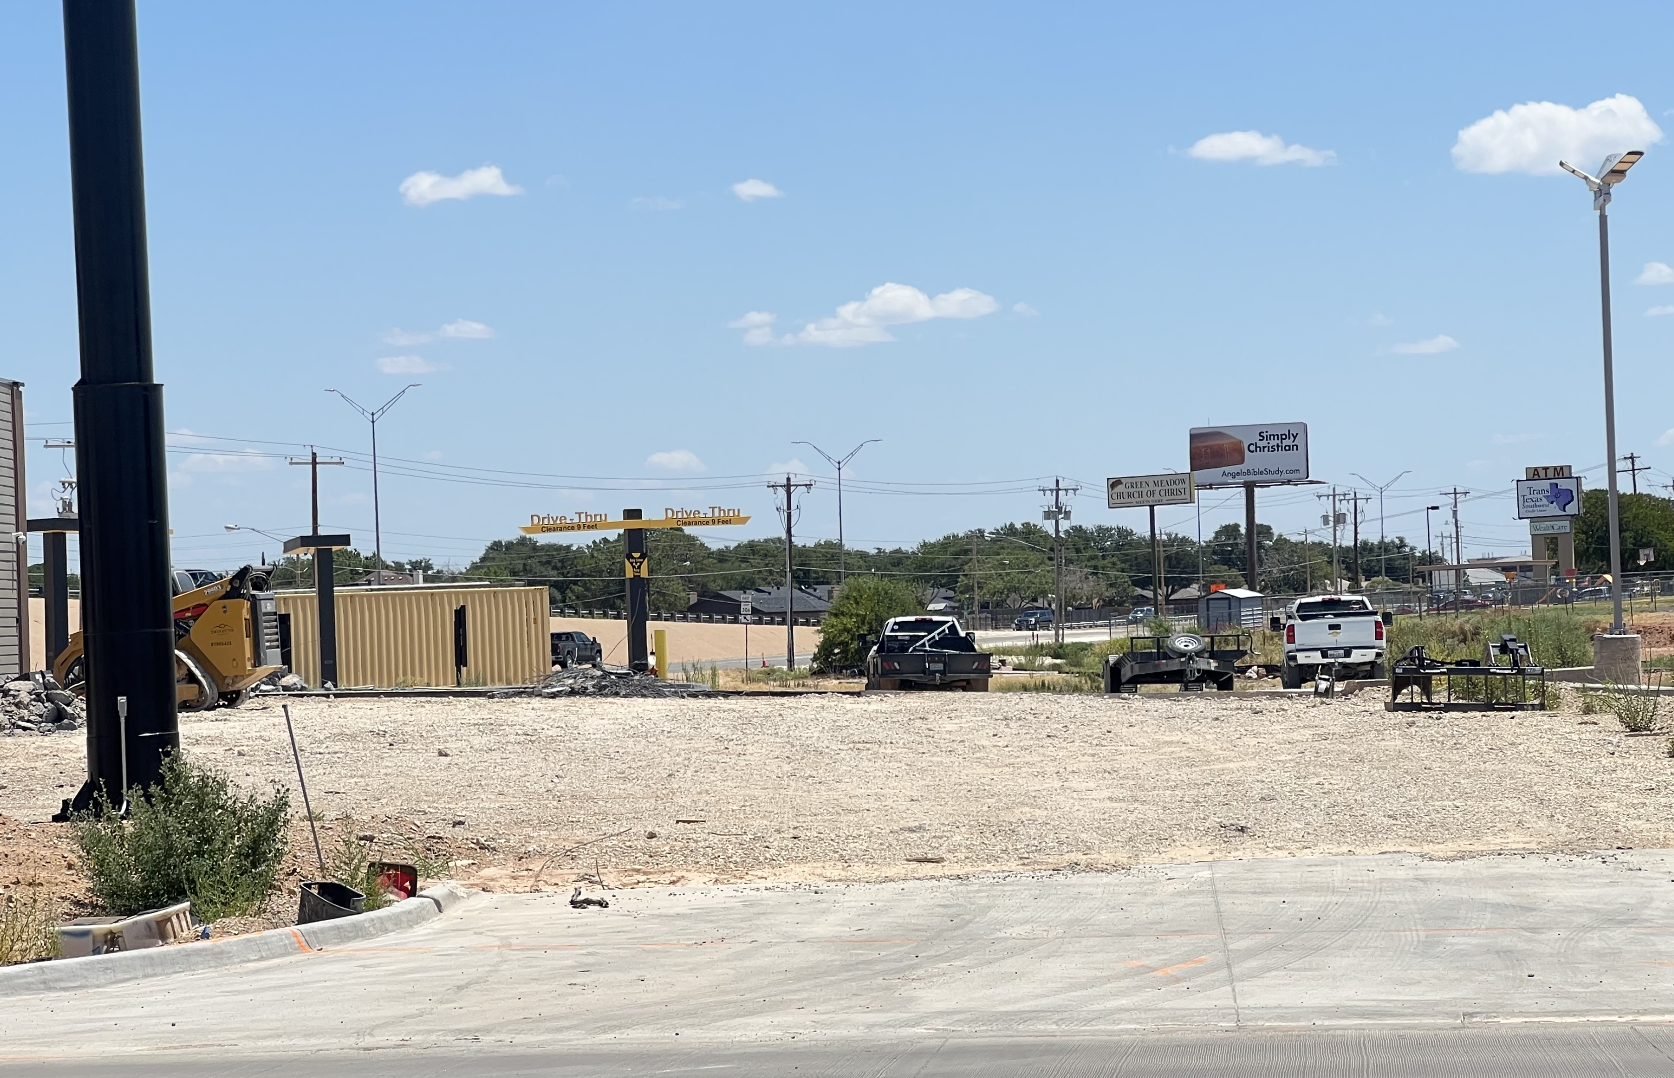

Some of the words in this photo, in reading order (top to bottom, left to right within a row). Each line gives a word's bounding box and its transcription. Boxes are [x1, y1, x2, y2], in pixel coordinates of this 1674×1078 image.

[1258, 429, 1299, 443] Simply
[1247, 442, 1299, 453] Christian
[1221, 467, 1301, 479] AngeloBibleStudy.com
[1532, 466, 1564, 478] ATM
[1124, 480, 1150, 489] GREEN
[1153, 478, 1187, 488] MEADOW
[1110, 490, 1143, 501] CHURCH
[1145, 489, 1157, 498] OF
[1158, 487, 1188, 497] CHRIST
[1527, 486, 1549, 495] Trans
[1521, 494, 1543, 504] Texas
[540, 525, 576, 533] Clearance
[576, 523, 582, 531] 9
[676, 519, 710, 527] Clearance
